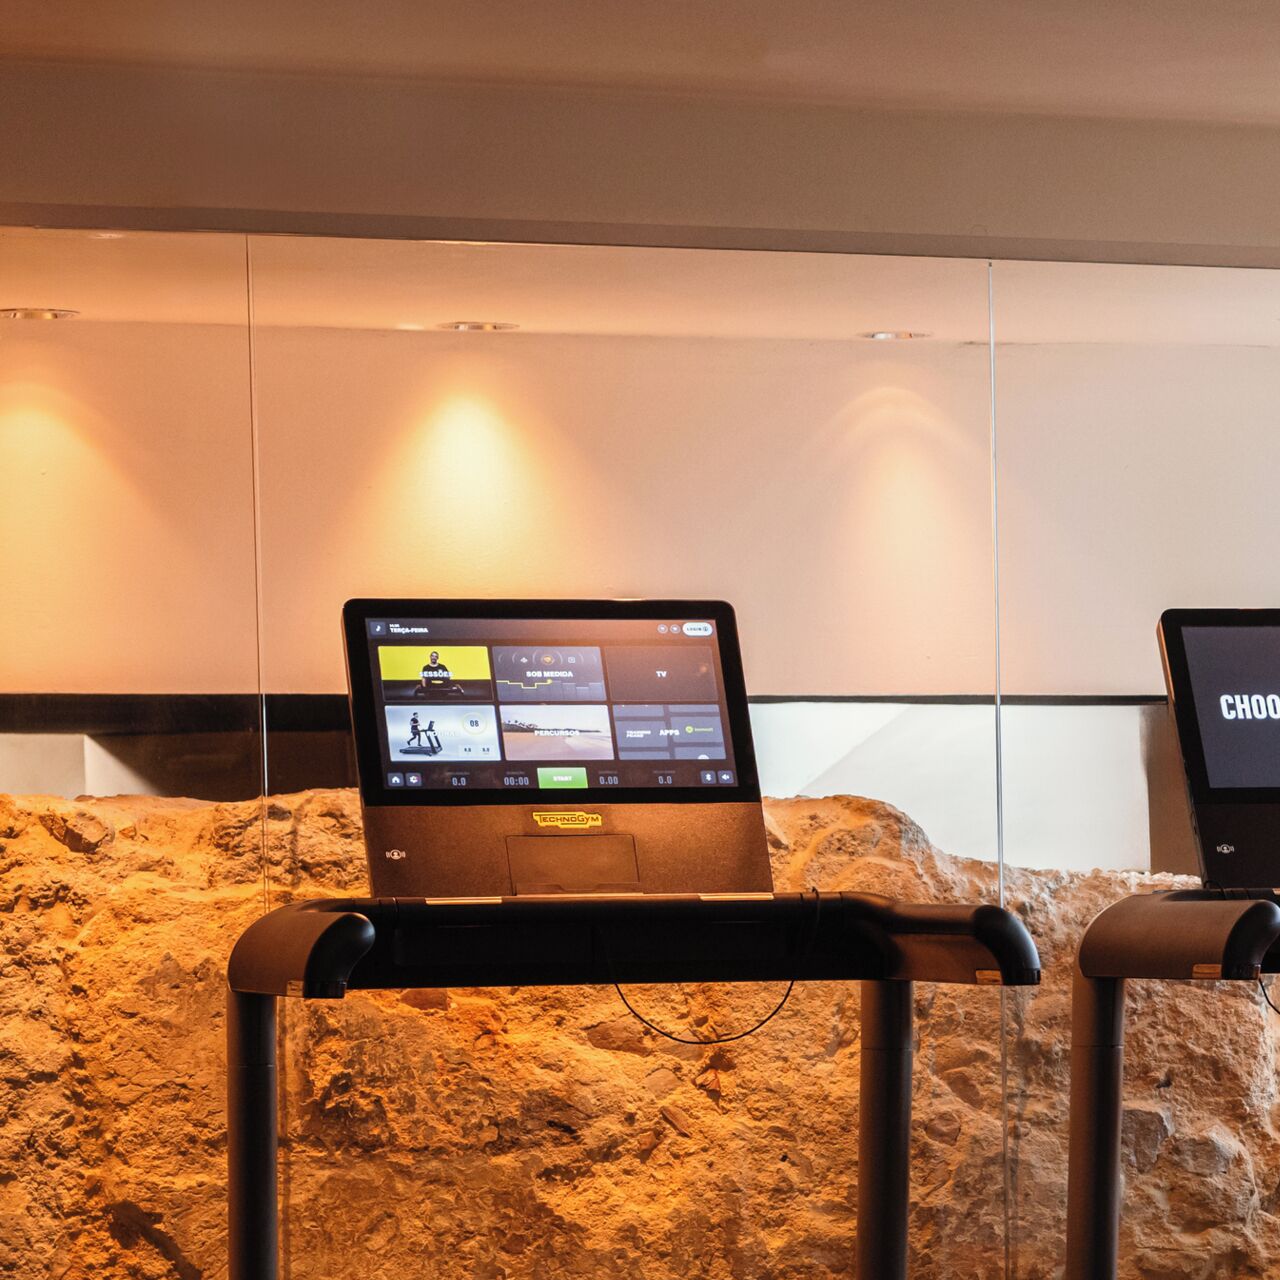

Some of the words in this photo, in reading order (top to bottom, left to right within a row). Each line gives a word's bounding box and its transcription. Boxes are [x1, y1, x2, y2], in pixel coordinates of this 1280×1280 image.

[419, 669, 454, 678] SESSÕES
[470, 719, 480, 727] 08
[452, 777, 466, 786] 0.0
[503, 776, 529, 786] 00:00
[599, 776, 618, 785] 0.00
[658, 775, 672, 784] 0.0
